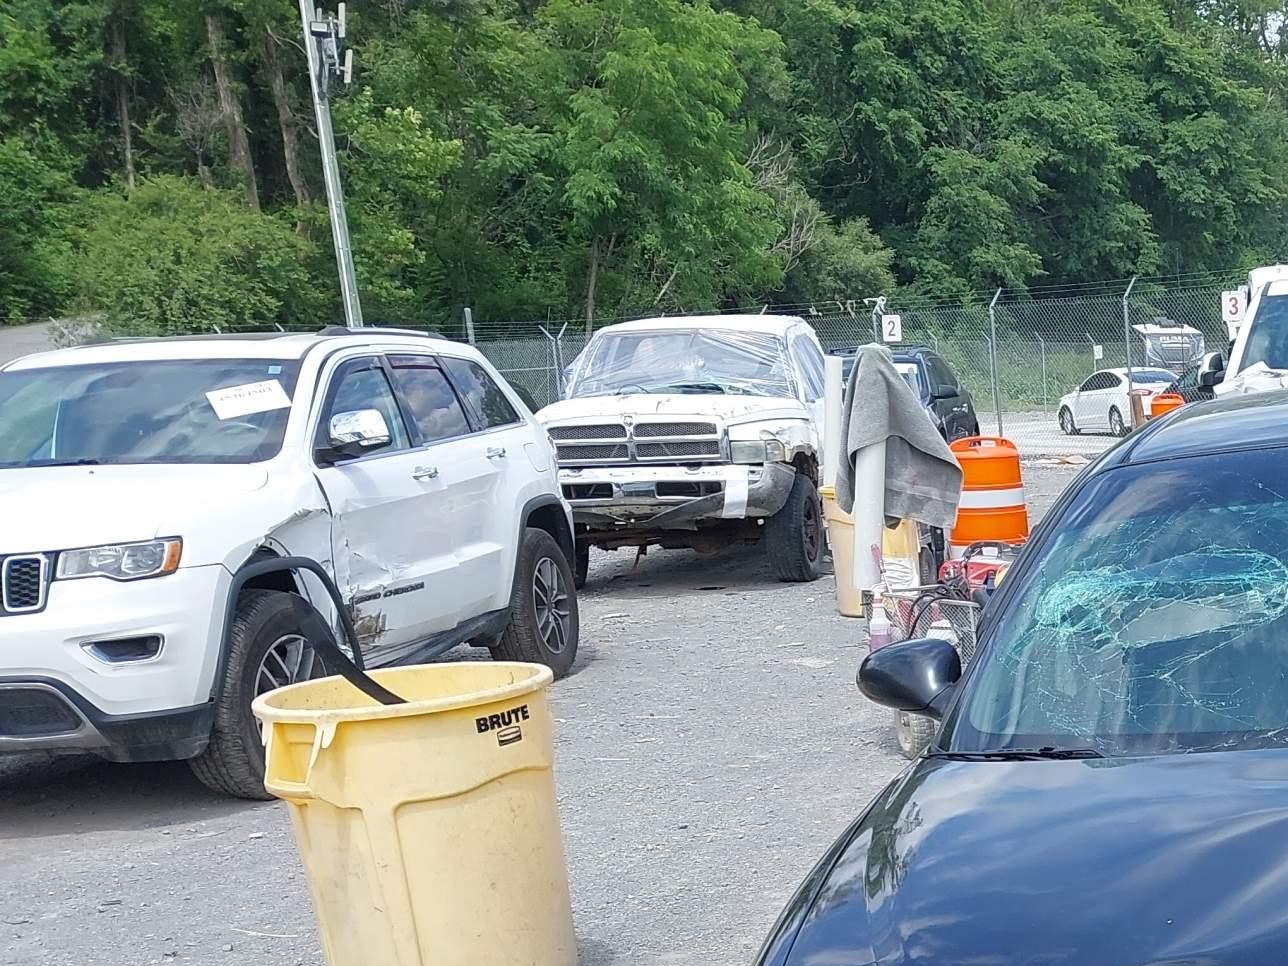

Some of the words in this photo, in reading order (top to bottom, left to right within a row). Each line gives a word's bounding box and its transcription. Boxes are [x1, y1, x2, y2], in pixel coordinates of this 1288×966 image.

[1228, 297, 1239, 316] 3
[887, 320, 896, 337] 2
[475, 704, 530, 733] BRUTE
